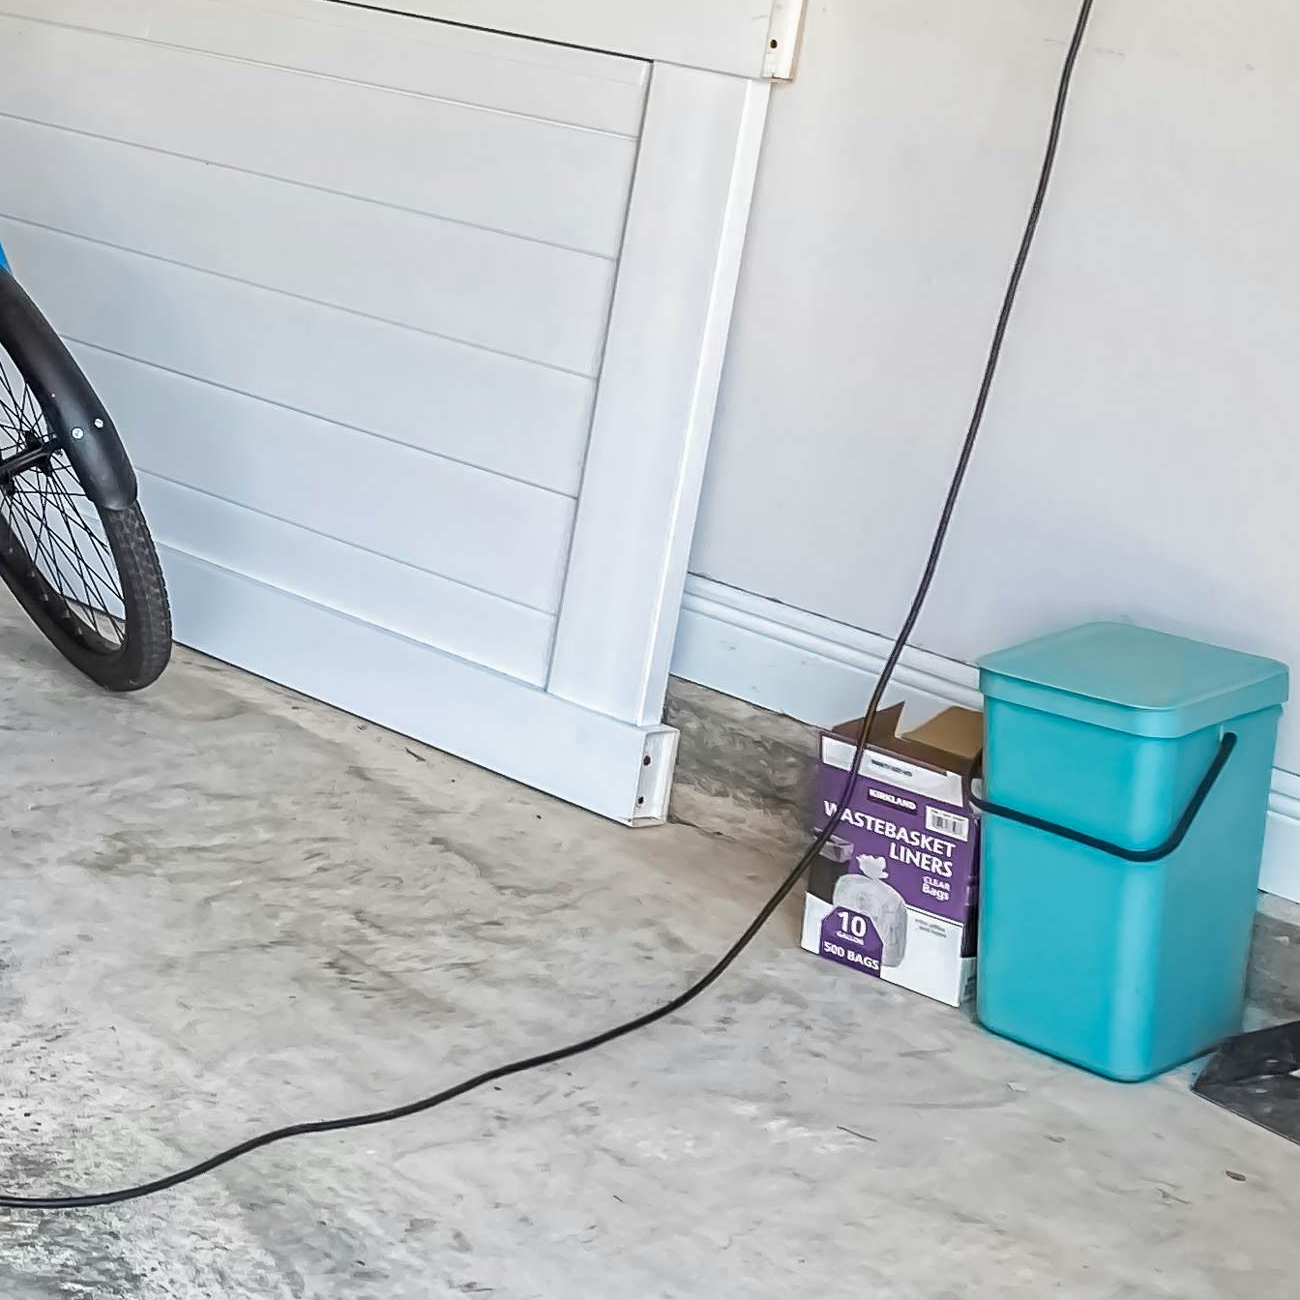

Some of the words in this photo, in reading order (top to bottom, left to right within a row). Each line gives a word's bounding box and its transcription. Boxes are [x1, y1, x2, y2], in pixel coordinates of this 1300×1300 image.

[869, 788, 917, 811] KIRKLAND
[824, 800, 956, 858] WASTEBASKET
[889, 842, 953, 878] LINERS
[922, 882, 950, 901] Bags
[923, 876, 951, 890] CLEAR
[837, 911, 867, 938] 10
[846, 950, 880, 971] BAGS
